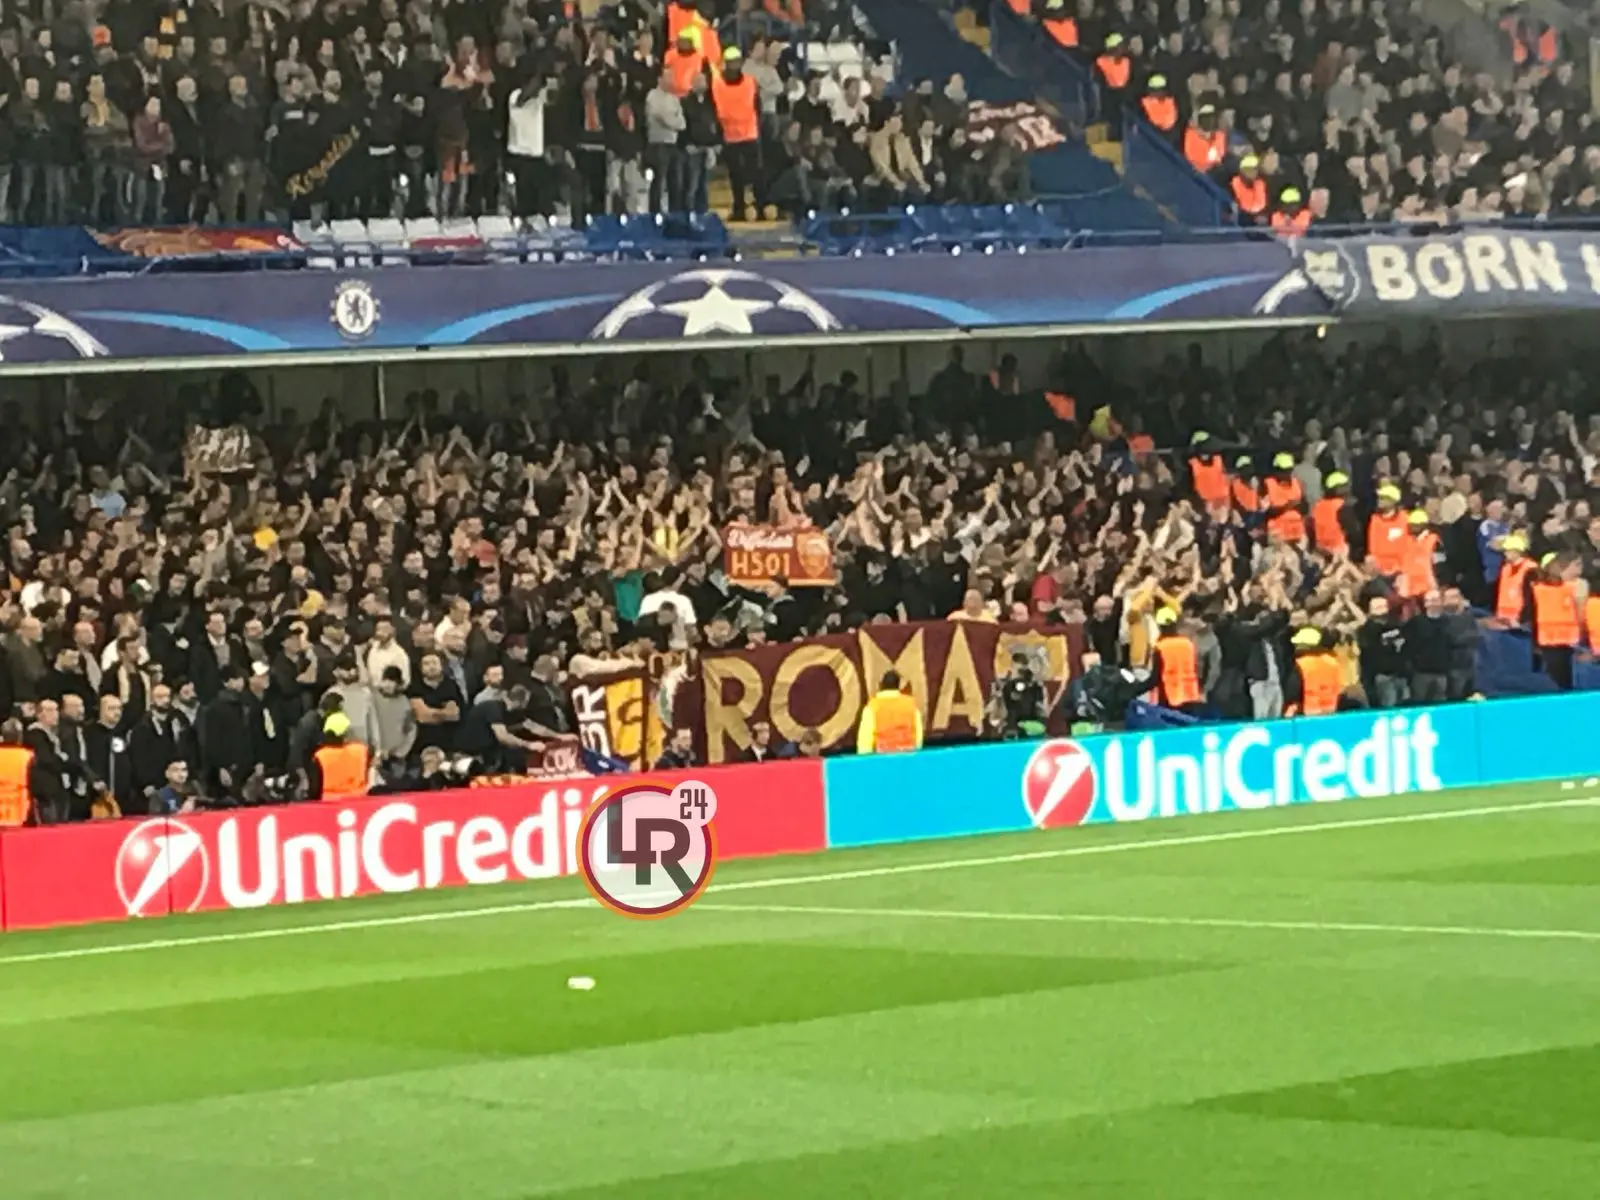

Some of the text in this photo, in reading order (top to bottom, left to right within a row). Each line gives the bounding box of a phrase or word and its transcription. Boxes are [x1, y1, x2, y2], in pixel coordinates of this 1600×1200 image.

[1366, 234, 1568, 301] BORN
[701, 623, 984, 763] ROMA
[1104, 712, 1443, 821] UniCredit
